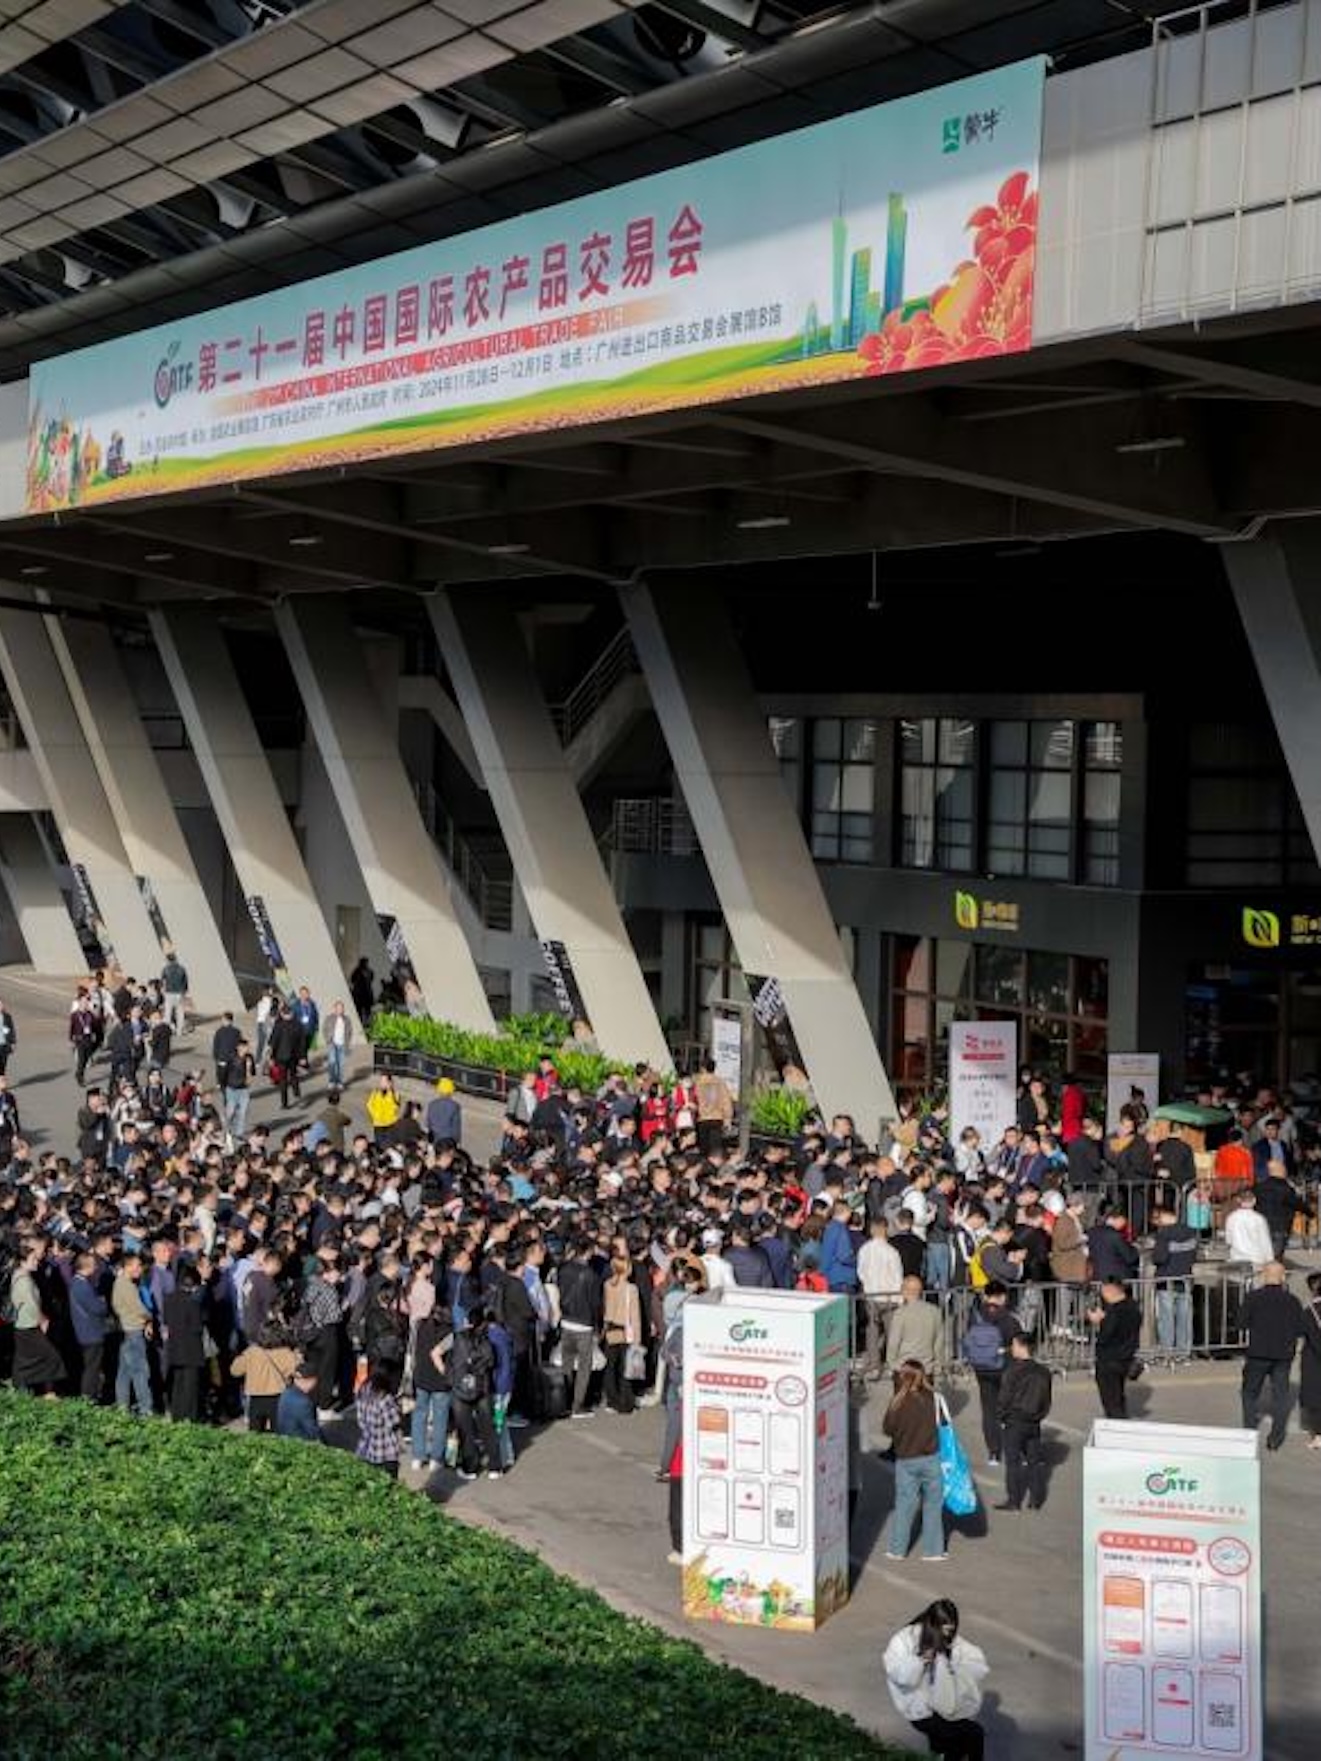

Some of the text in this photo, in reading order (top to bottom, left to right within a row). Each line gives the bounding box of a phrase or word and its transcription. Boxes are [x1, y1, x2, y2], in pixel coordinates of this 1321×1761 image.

[197, 204, 705, 393] 第二十一届中国国际农产品交易会
[423, 332, 525, 370] AGRICULTURAL
[530, 317, 580, 347] TRADE
[589, 306, 625, 335] FAIR
[154, 358, 194, 409] CATF
[1146, 1472, 1199, 1495] CATF
